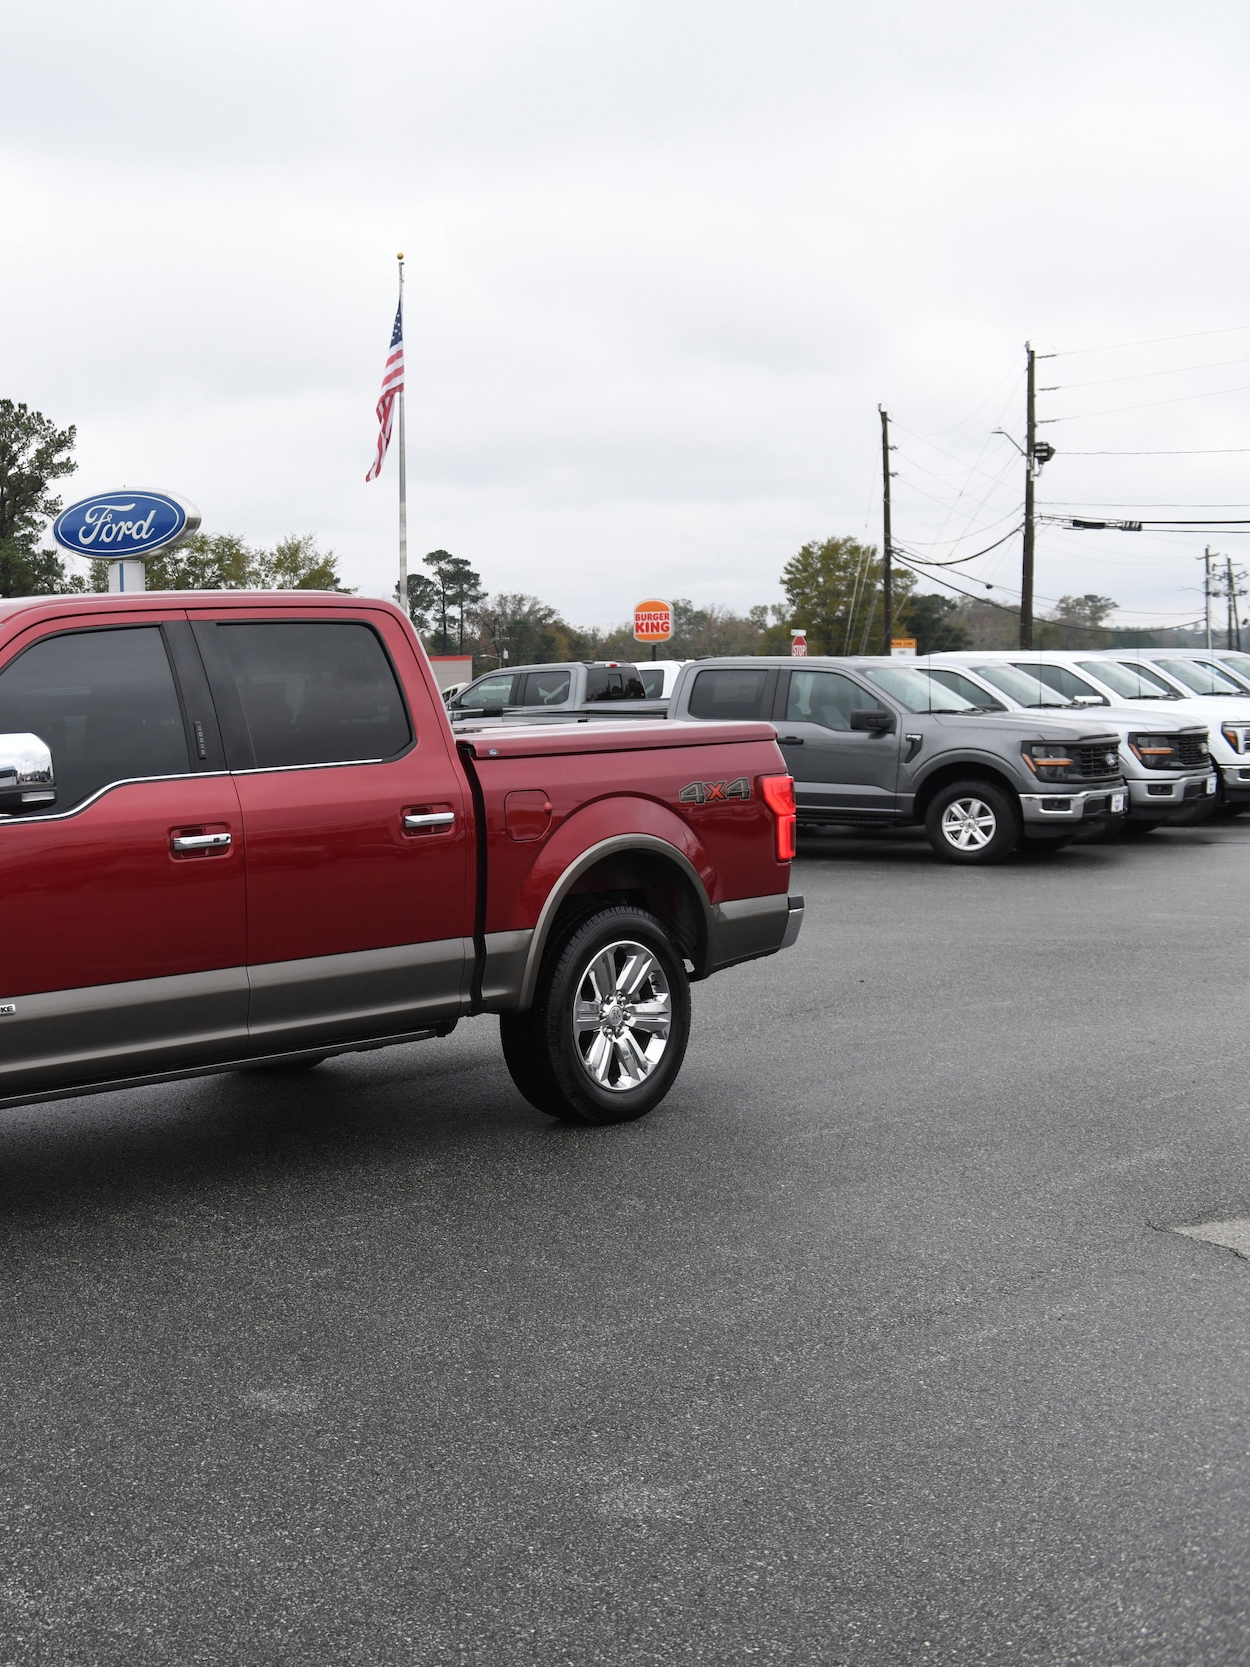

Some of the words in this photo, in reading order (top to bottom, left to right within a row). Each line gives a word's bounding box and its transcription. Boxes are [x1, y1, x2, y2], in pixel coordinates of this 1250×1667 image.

[78, 503, 156, 545] Ford
[635, 612, 670, 621] BURGER
[635, 621, 670, 633] KING
[792, 645, 806, 656] STOP
